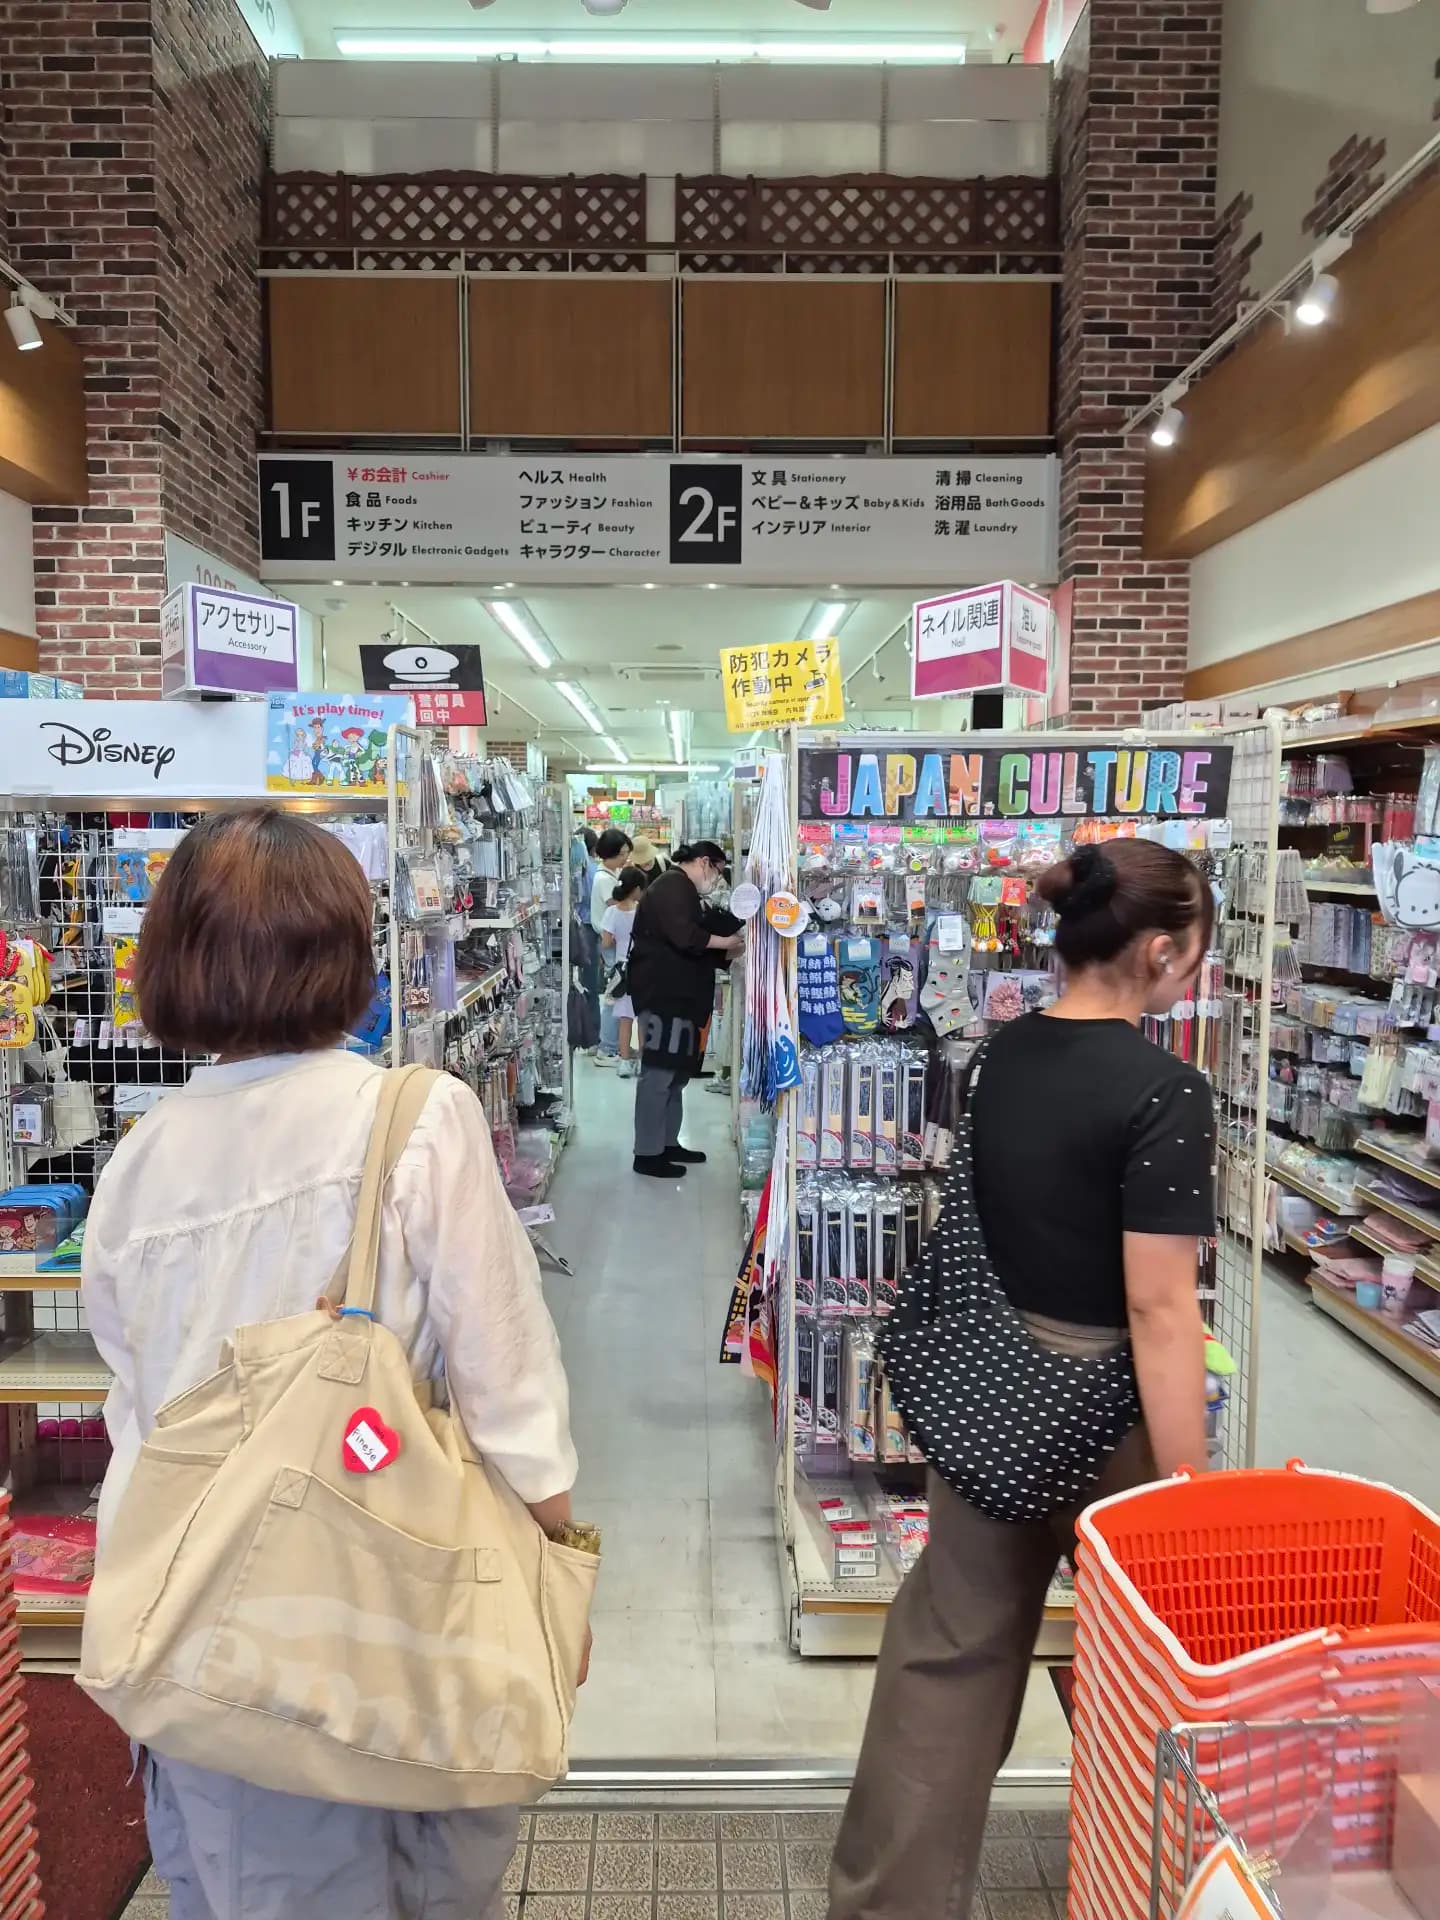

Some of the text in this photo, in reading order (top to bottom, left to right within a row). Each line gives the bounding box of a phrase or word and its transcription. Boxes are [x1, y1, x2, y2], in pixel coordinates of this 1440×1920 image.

[412, 471, 450, 481] Cashier
[519, 470, 607, 484] ヘルス Health
[751, 470, 846, 486] 文具 Stationery
[936, 470, 1023, 486] 清掃 Cleaning
[345, 491, 418, 508] 食品 Foods
[520, 495, 653, 510] ファッション Fashion
[935, 495, 1045, 511] 浴用品 Bath Goods
[270, 482, 321, 538] 1F
[678, 486, 737, 543] 2F
[347, 517, 453, 532] キッチン Kitchen
[520, 518, 635, 535] ビューティ Beauty
[751, 520, 871, 535] インテリア Interior
[934, 520, 1018, 536] 洗濯 Laundry
[347, 541, 509, 558] デジタル Electronic Gadgets
[520, 544, 661, 560] キャラクター Character
[201, 601, 291, 637] アクセサリー
[922, 599, 999, 639] ネイル関連
[228, 637, 268, 655] Accessory
[729, 644, 831, 674] 防犯カメラ
[731, 673, 793, 699] 作動中
[409, 693, 466, 708] 警備員
[292, 703, 385, 720] It's play time!
[416, 709, 450, 723] 回中
[998, 750, 1213, 817] CULTURE
